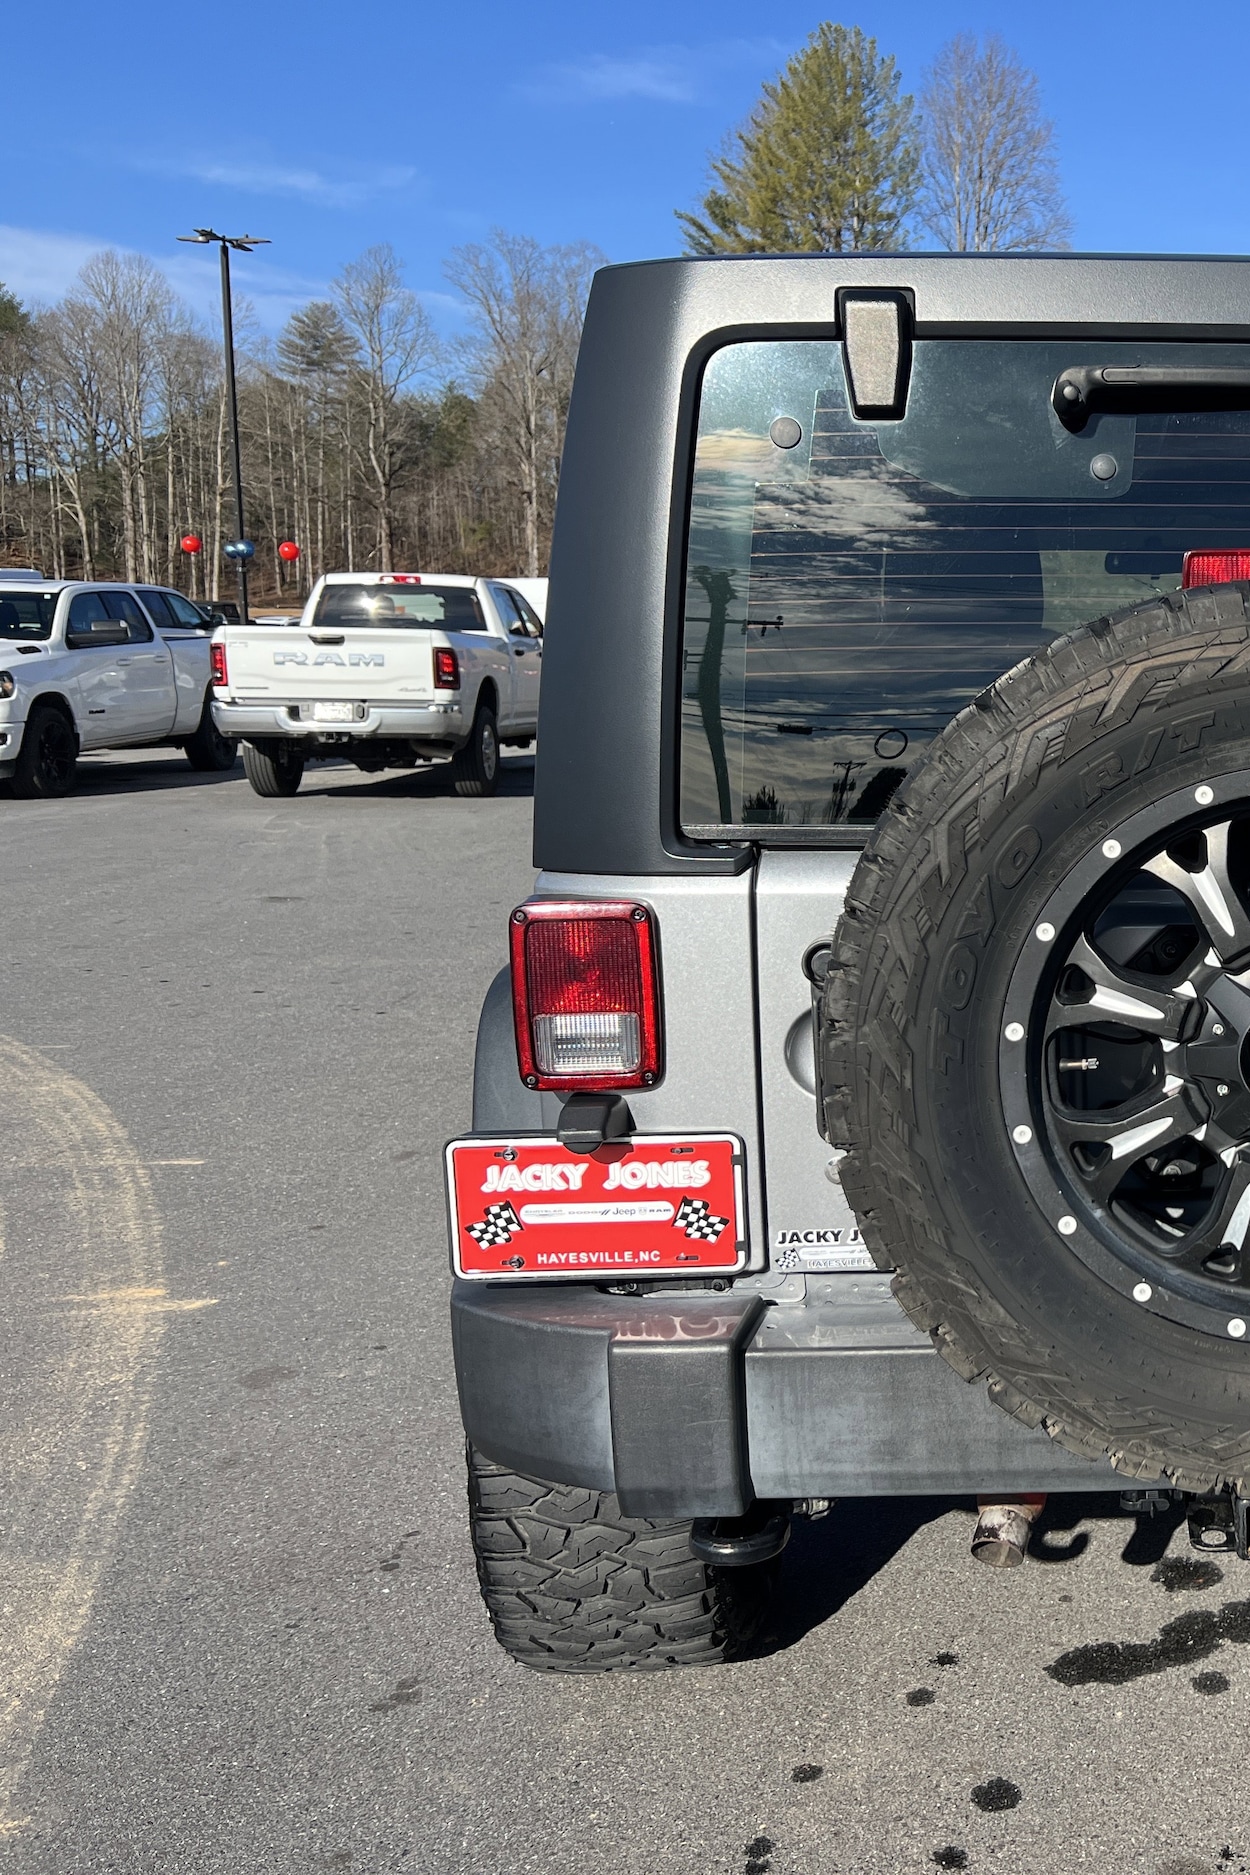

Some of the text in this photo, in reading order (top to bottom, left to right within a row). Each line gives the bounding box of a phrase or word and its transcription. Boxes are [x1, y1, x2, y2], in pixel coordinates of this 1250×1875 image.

[273, 651, 385, 667] RAM
[929, 824, 1043, 1076] TOYO
[480, 1159, 712, 1193] JACKY JONES
[612, 1207, 636, 1217] Jeep
[777, 1228, 843, 1245] JACKY
[536, 1250, 661, 1266] HAYESVILLE,NC
